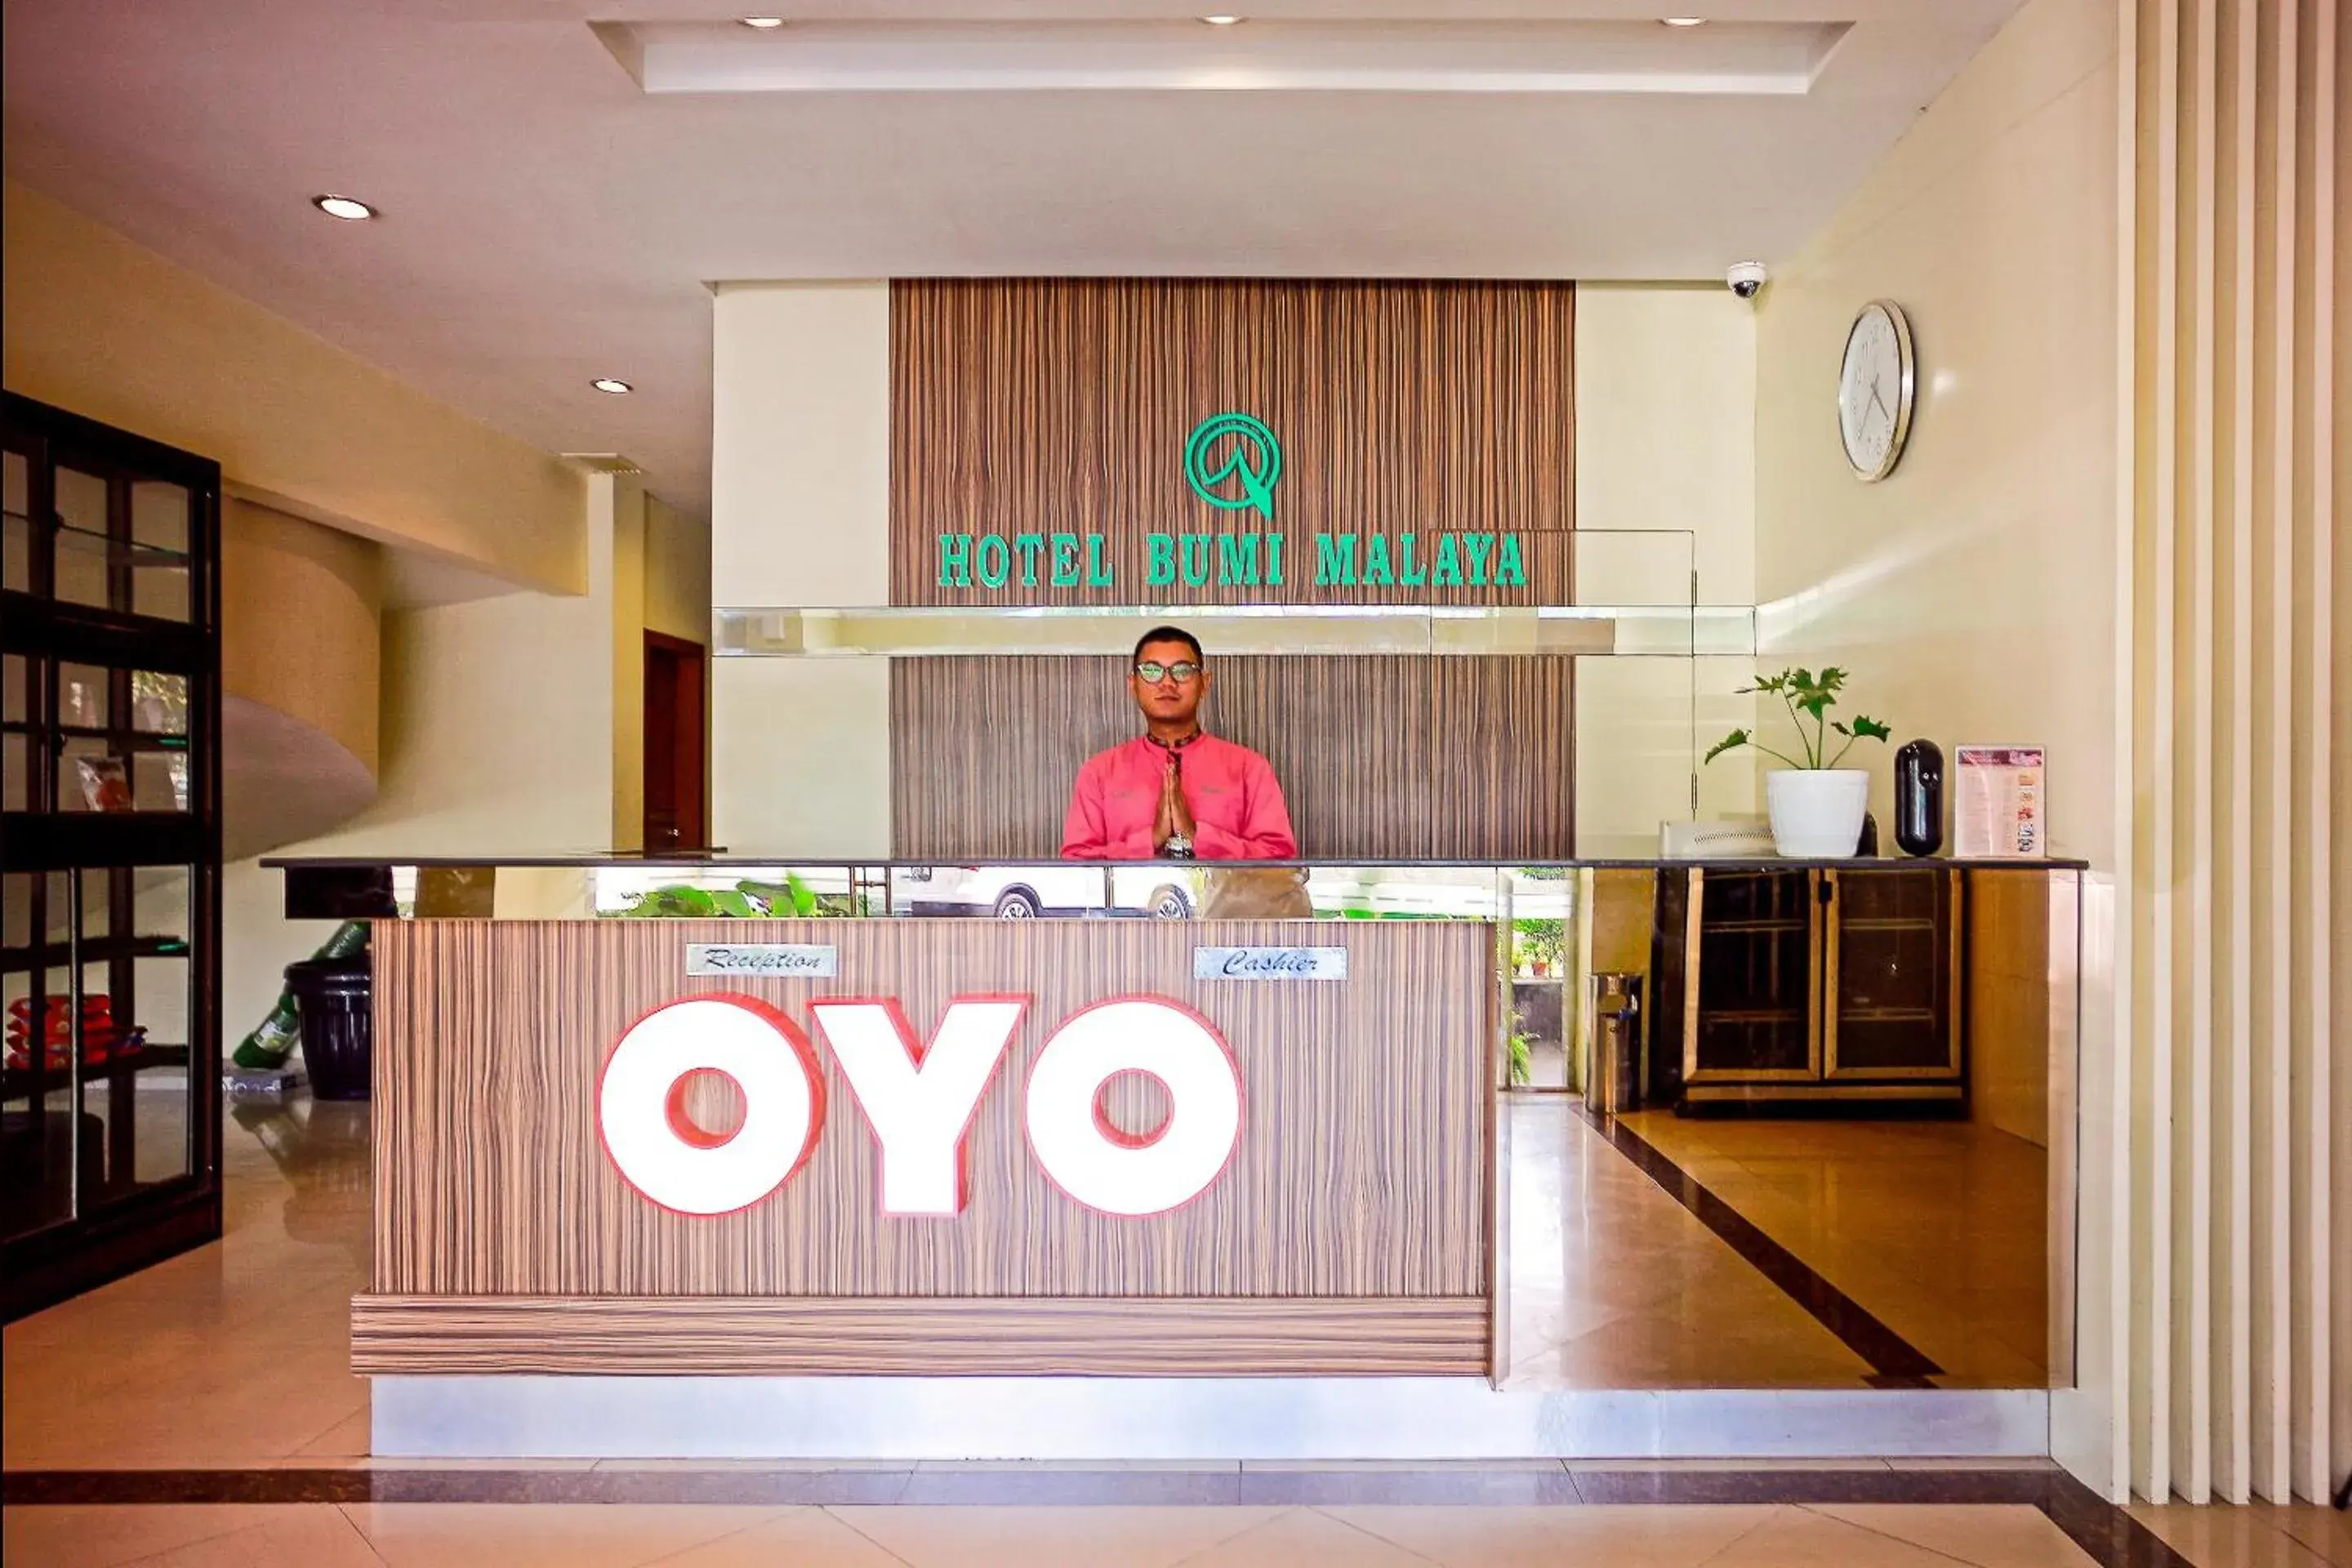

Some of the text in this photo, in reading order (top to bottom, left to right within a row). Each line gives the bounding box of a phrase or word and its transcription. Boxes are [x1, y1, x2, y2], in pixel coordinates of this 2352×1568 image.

[938, 532, 1527, 587] HOTEL BUMI MALAYA
[704, 948, 822, 972] Reception
[1222, 949, 1318, 974] Cashier
[596, 992, 1245, 1217] OYO
